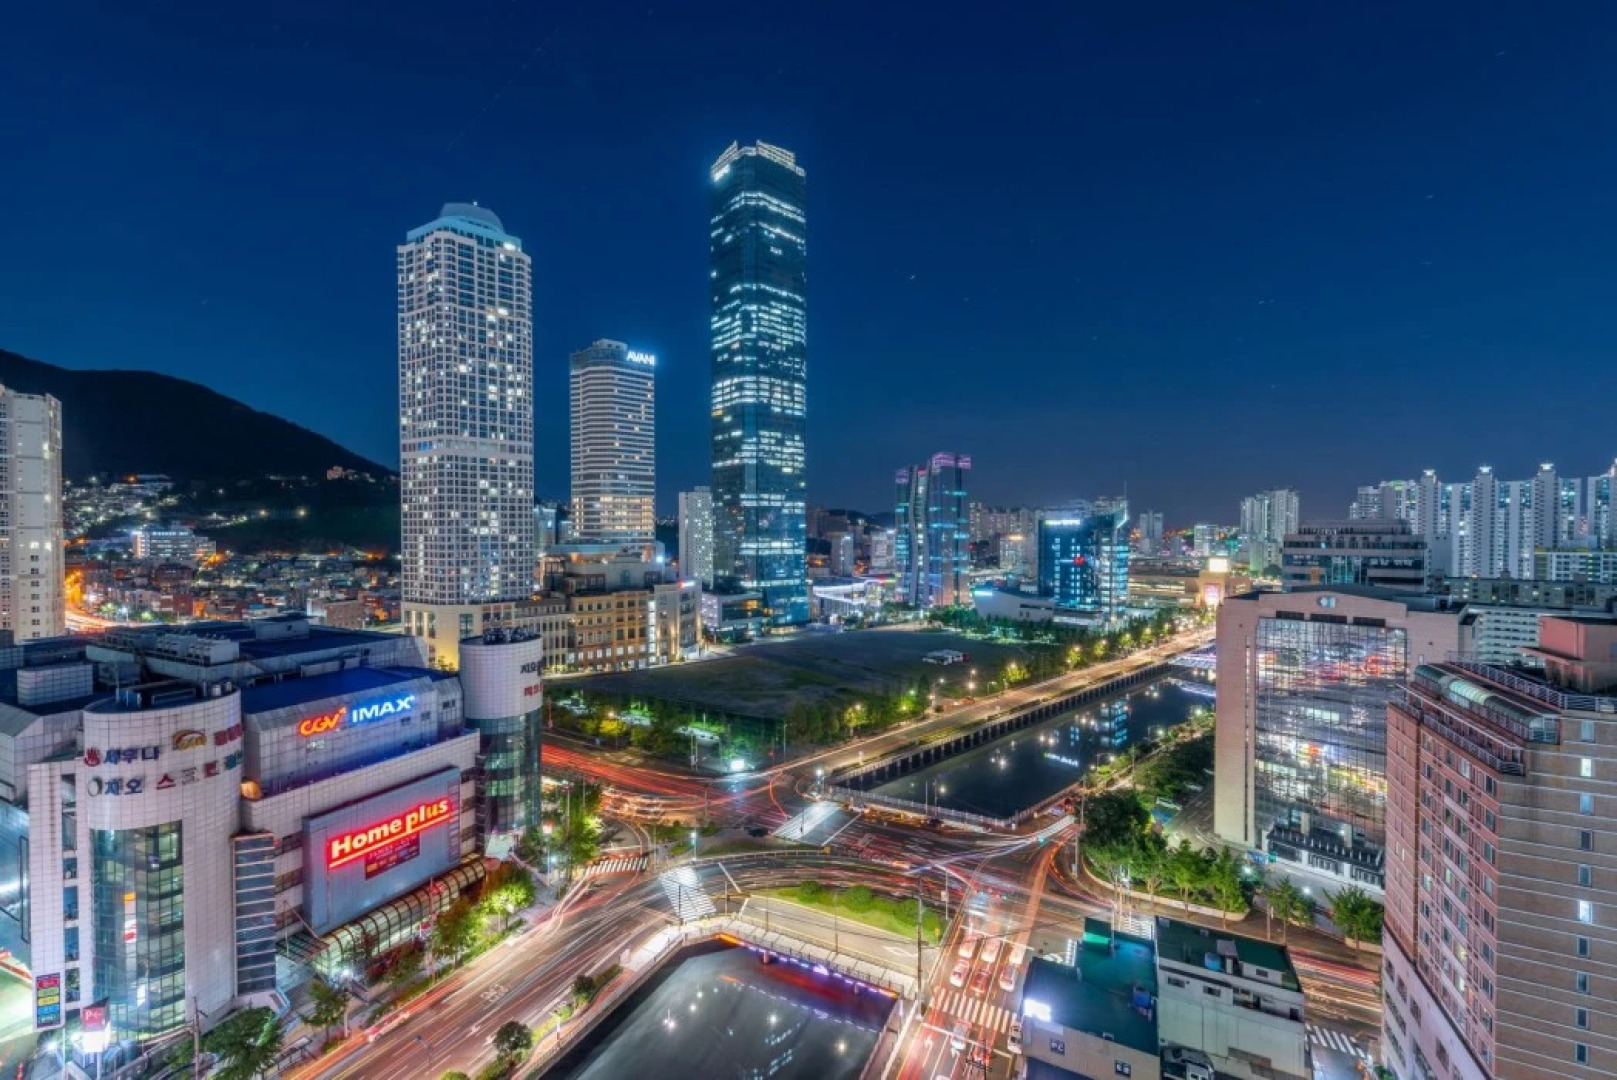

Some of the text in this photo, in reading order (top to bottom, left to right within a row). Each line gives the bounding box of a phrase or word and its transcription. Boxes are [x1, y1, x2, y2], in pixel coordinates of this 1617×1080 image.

[299, 697, 412, 737] CGV IMAX
[331, 818, 402, 859] Home
[405, 799, 449, 834] plus
